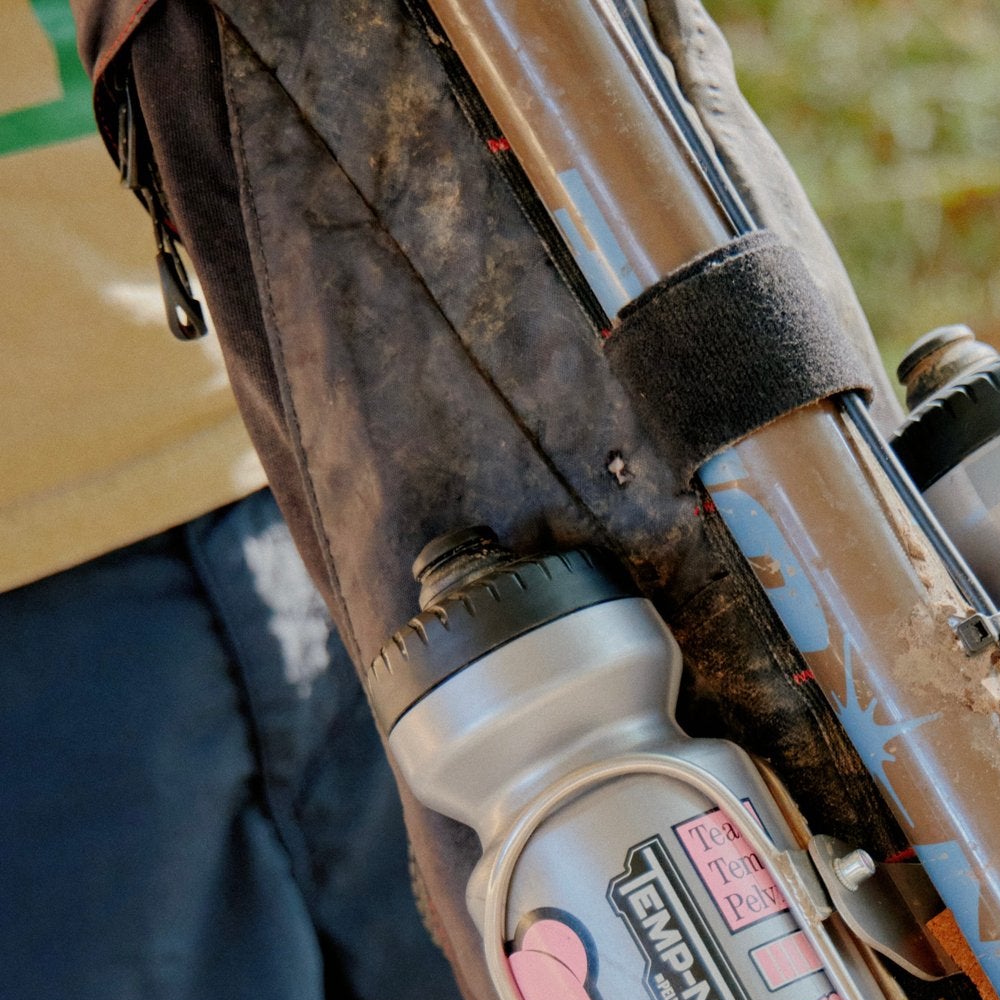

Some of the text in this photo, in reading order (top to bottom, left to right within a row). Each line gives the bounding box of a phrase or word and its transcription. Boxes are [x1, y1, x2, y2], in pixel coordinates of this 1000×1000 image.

[688, 821, 744, 854] Tea
[707, 850, 768, 887] Tem
[724, 884, 787, 922] Pelv
